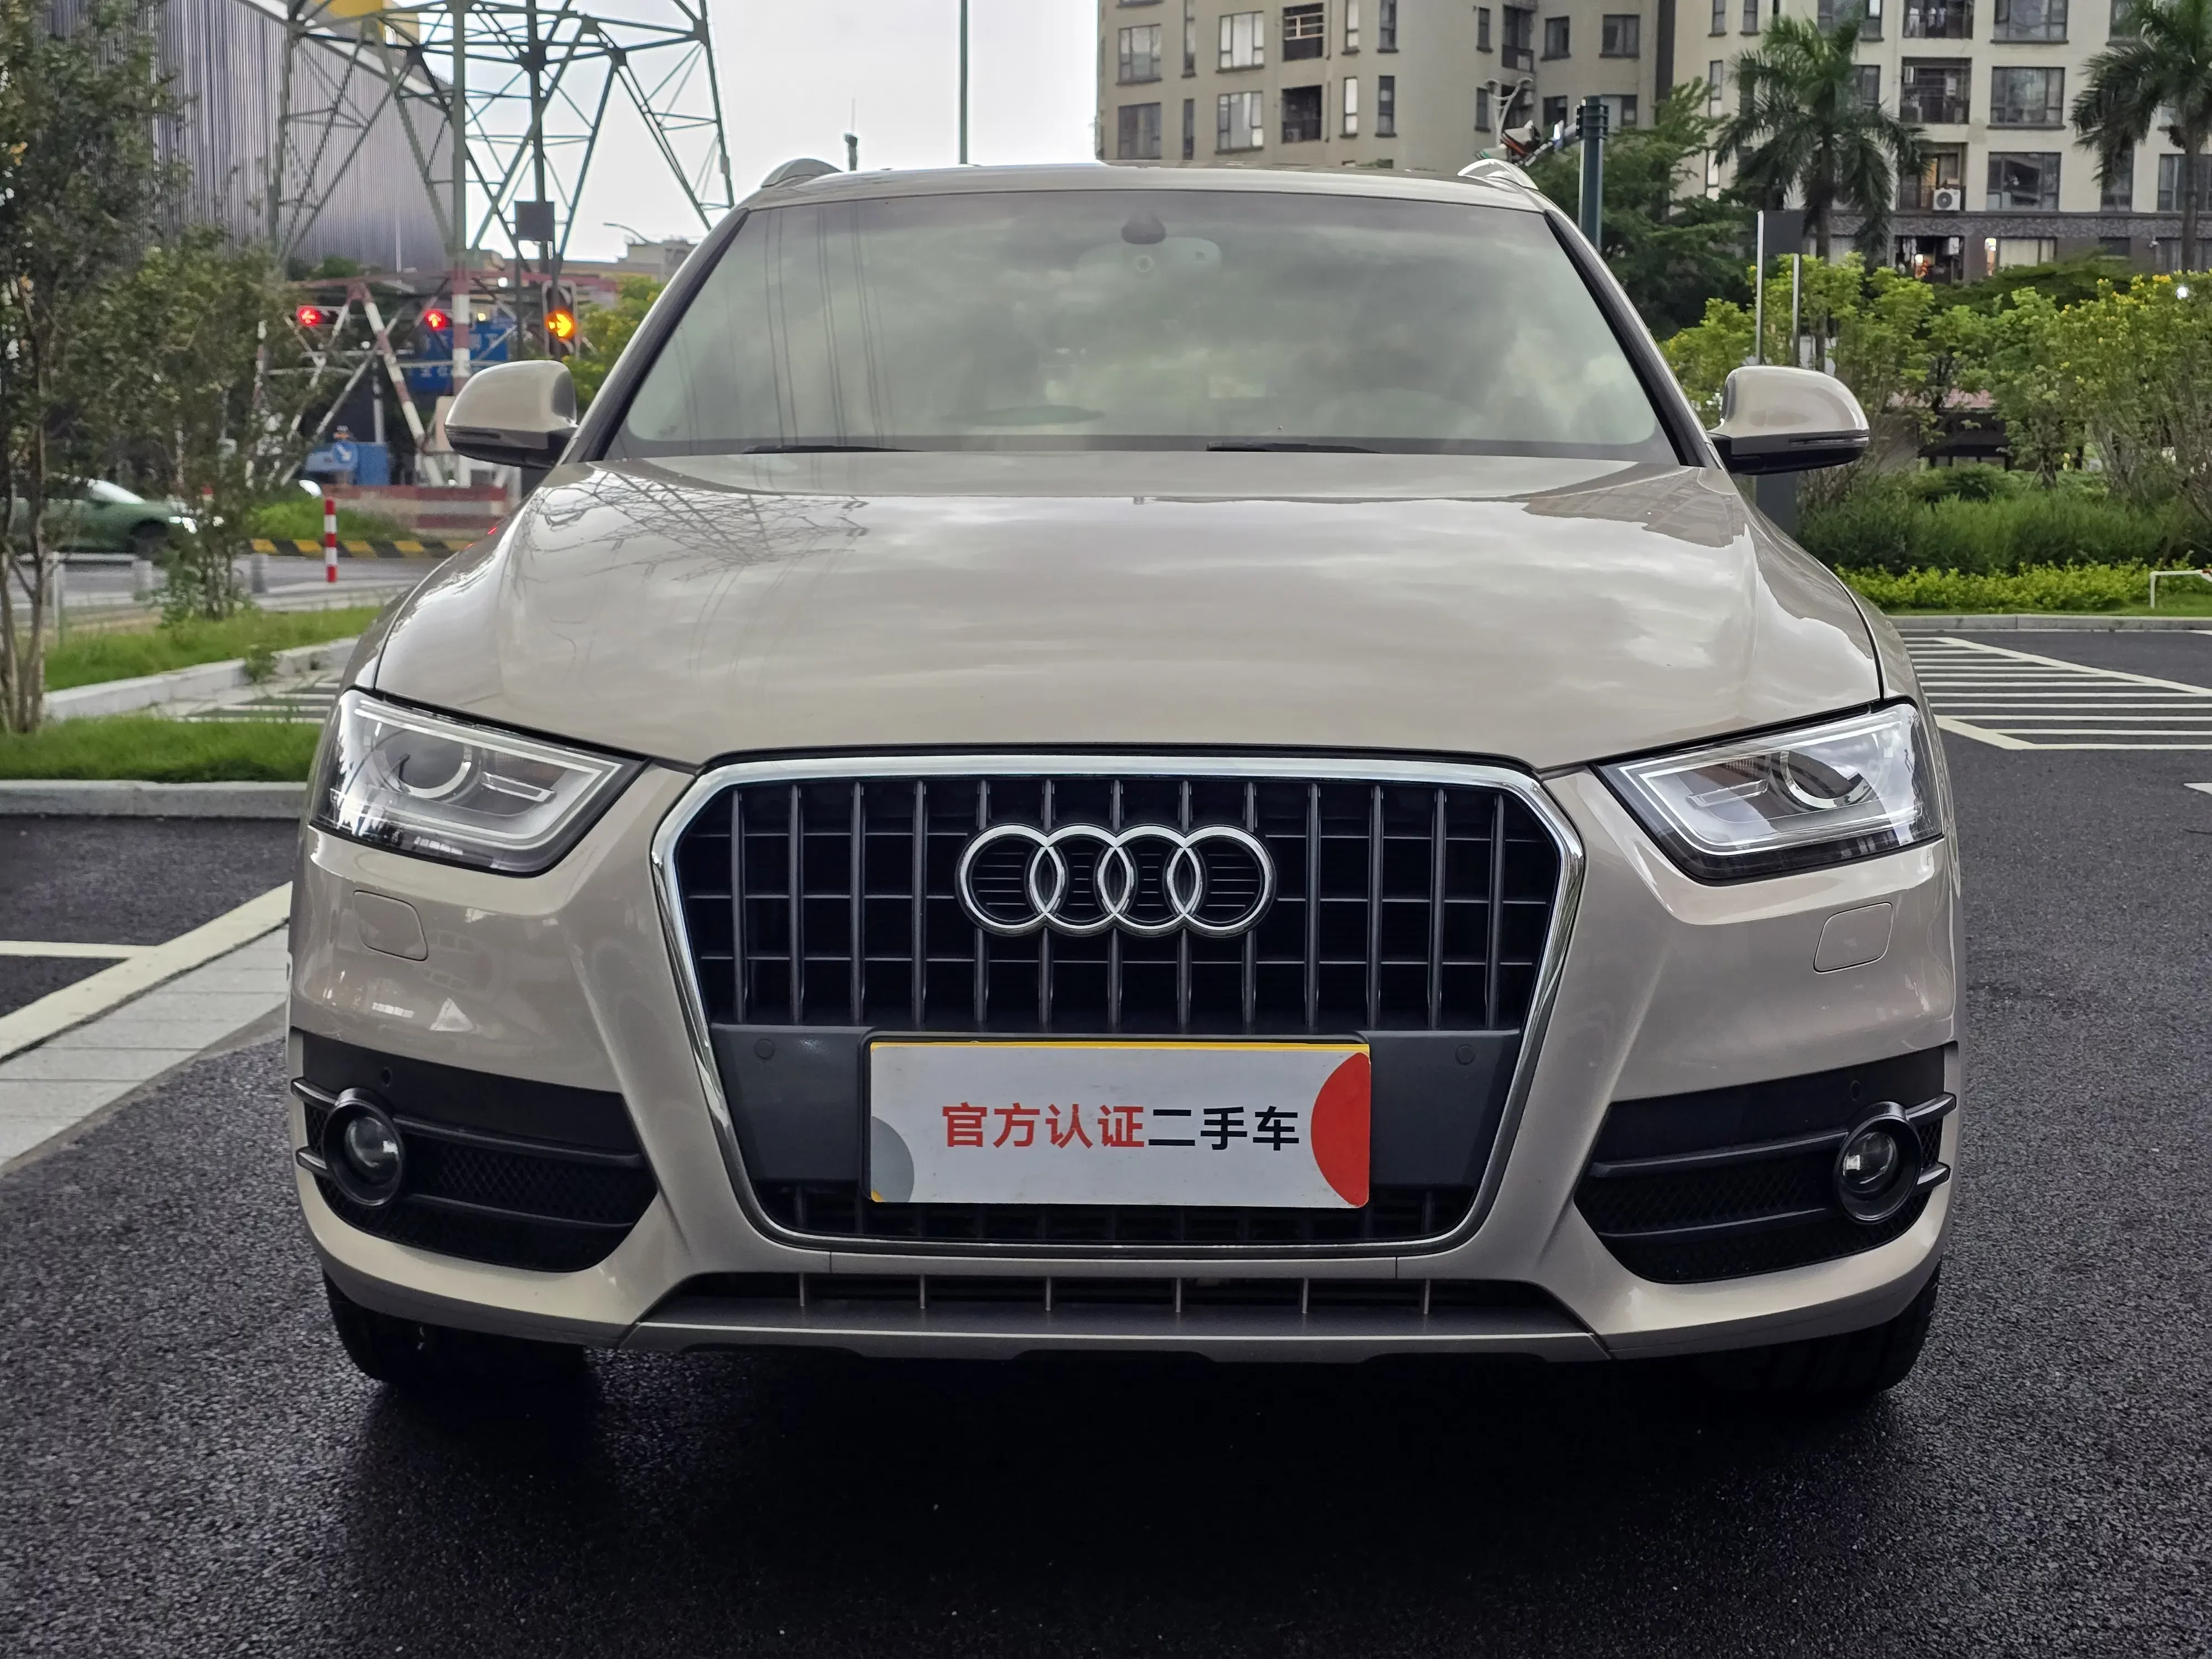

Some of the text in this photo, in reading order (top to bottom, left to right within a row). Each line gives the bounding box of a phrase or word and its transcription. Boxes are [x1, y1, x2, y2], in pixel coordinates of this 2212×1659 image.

[941, 1102, 1300, 1151] 官方认证二手车
